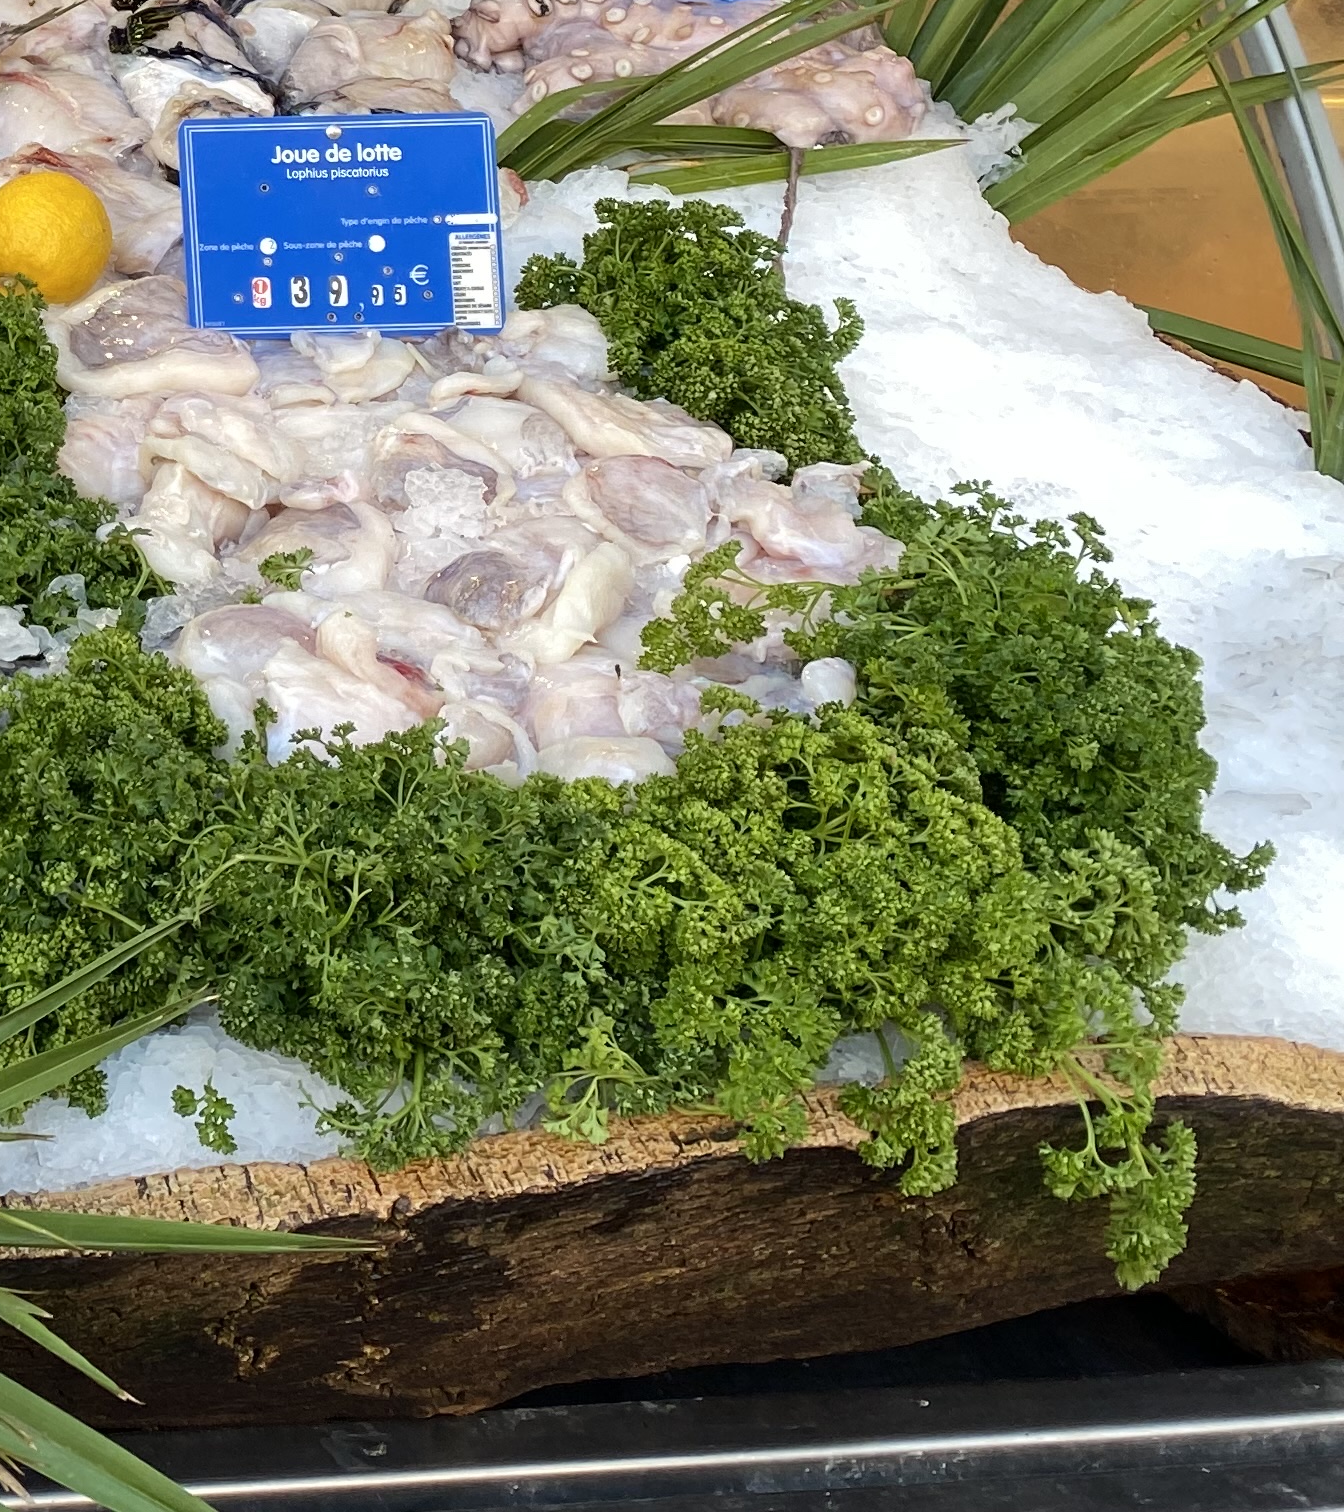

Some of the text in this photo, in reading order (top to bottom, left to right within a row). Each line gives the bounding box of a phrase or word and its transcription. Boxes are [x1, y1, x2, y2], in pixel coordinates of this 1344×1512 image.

[271, 143, 403, 164] Joue de lotte
[286, 167, 390, 180] Lophius piscatorius
[409, 264, 430, 286] €
